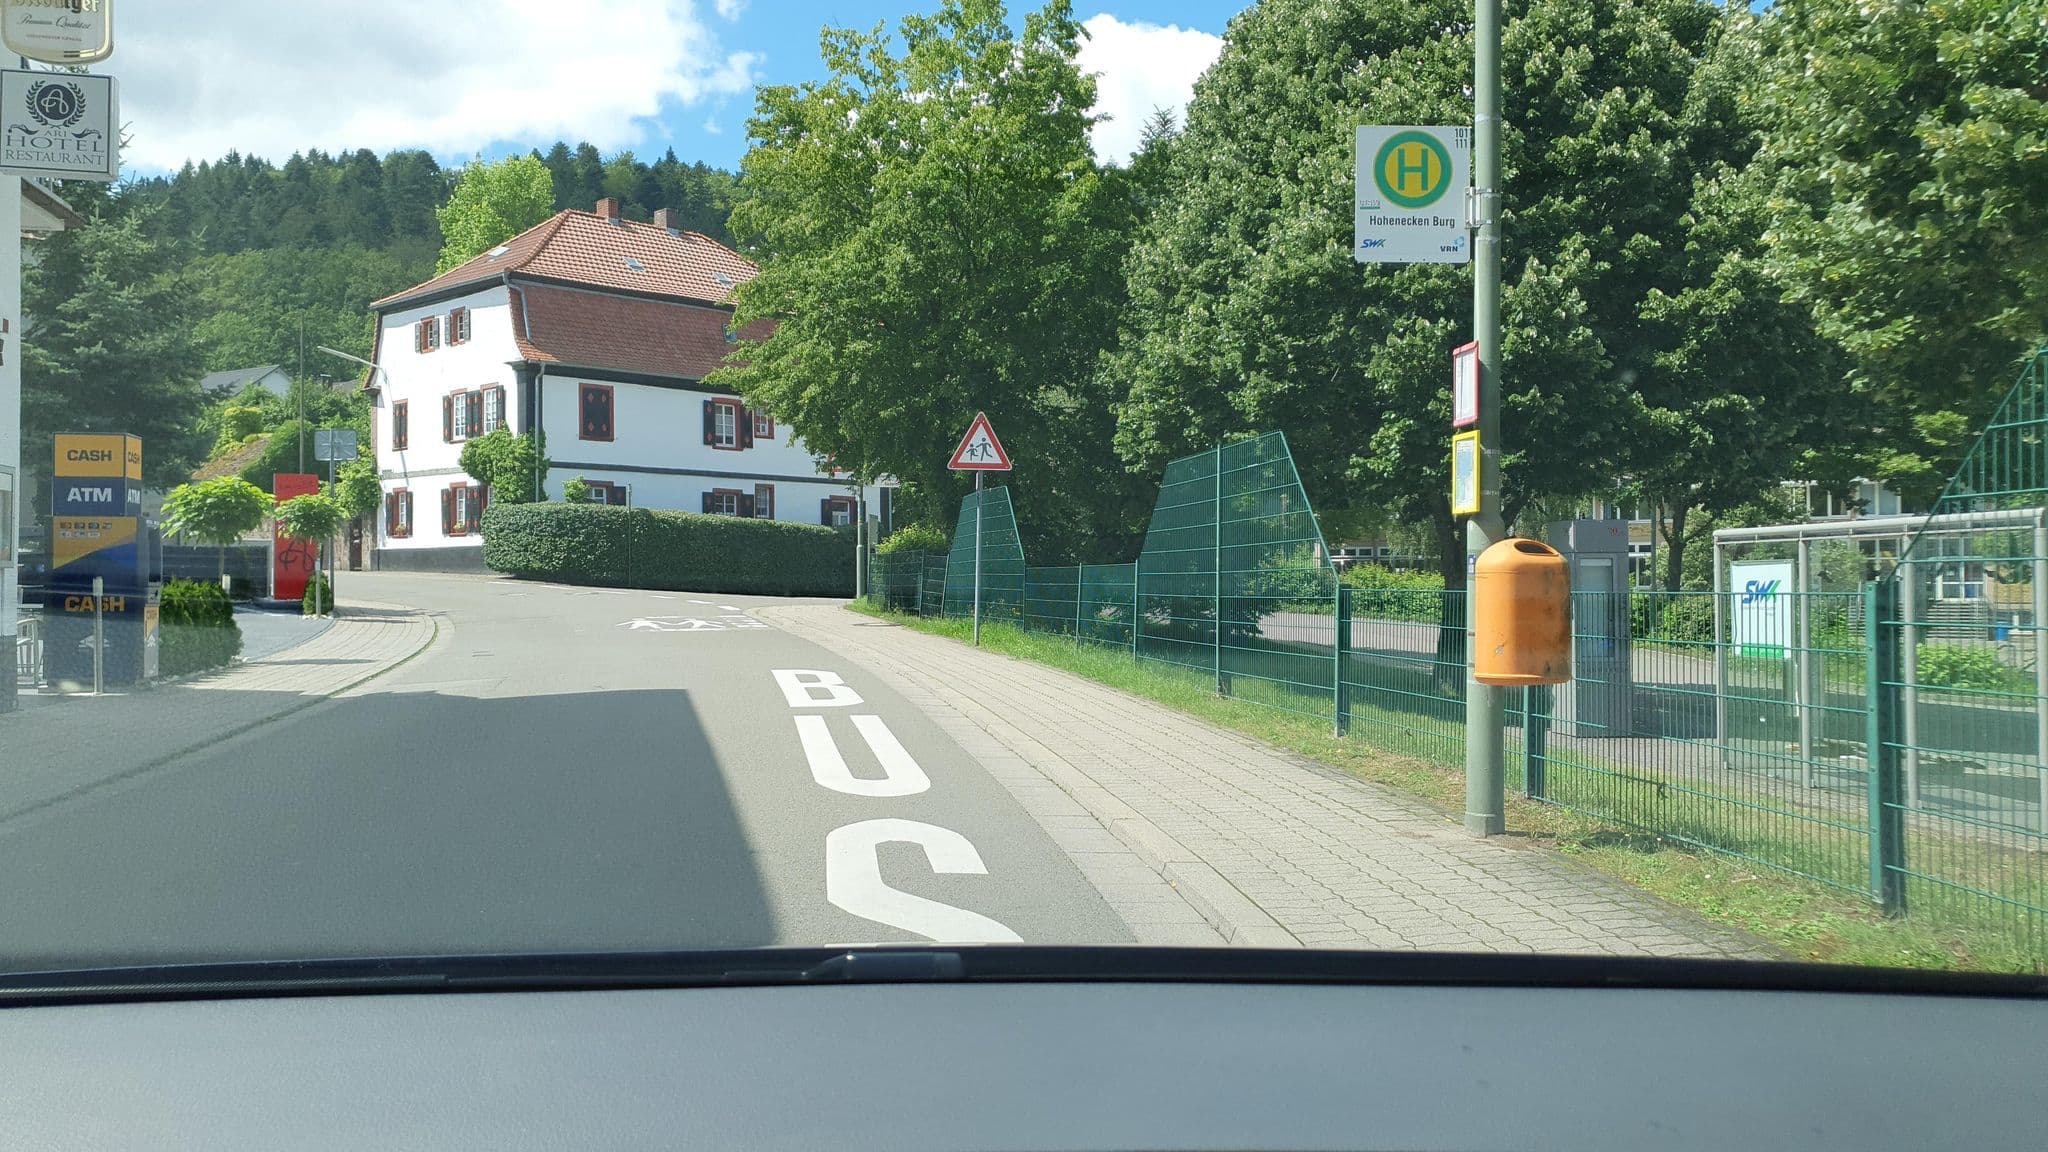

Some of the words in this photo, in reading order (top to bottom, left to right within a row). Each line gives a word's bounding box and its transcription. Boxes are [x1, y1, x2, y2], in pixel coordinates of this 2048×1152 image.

[44, 130, 67, 138] ARI
[1454, 128, 1468, 138] 101
[6, 134, 105, 153] HOTEL
[1455, 139, 1468, 149] 111
[5, 150, 105, 166] RESTAURANT
[1397, 148, 1429, 191] H
[1369, 215, 1430, 226] Hohenecken
[1432, 215, 1456, 229] Burg
[67, 450, 112, 462] CASH
[127, 451, 140, 464] CASH
[67, 487, 112, 502] ATM
[127, 488, 141, 504] ATM
[64, 595, 126, 612] CASH
[771, 668, 1025, 947] BUS
